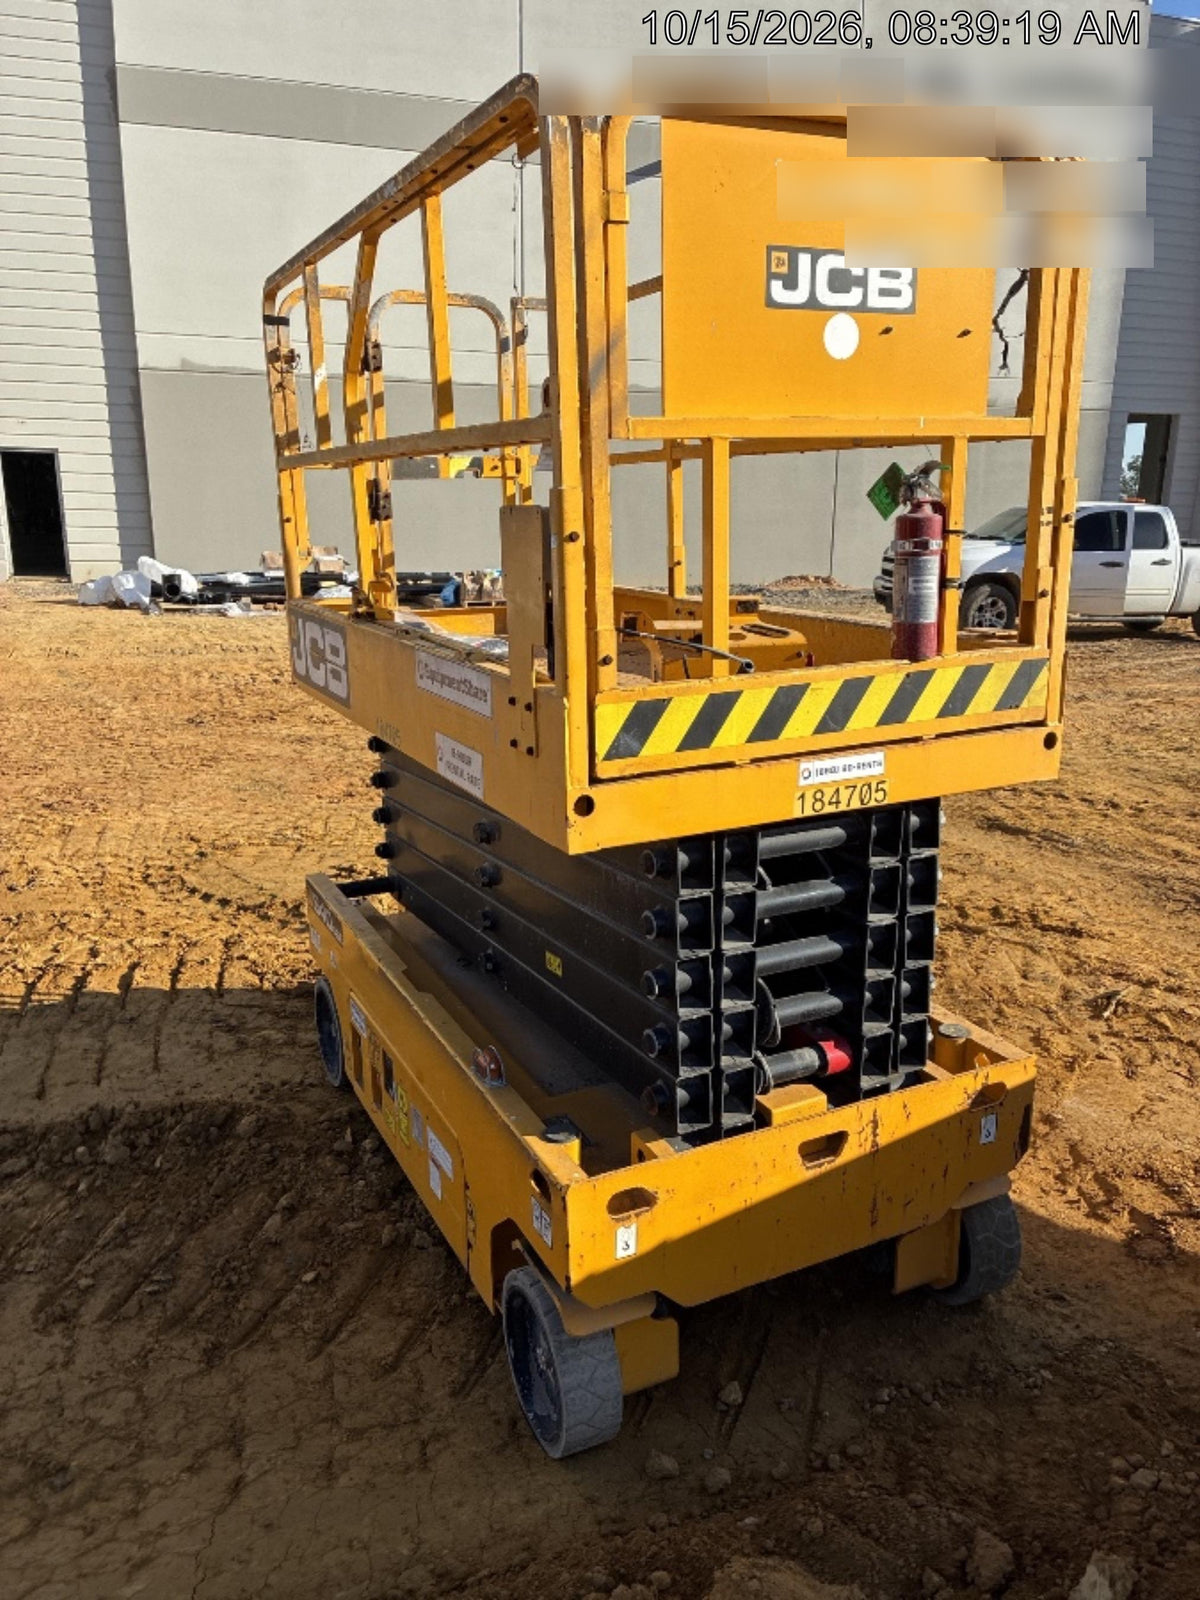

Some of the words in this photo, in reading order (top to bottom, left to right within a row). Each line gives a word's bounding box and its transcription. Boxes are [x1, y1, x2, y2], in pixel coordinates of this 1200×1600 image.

[770, 253, 913, 309] JCB
[293, 617, 348, 699] JCB
[797, 781, 887, 814] 184705
